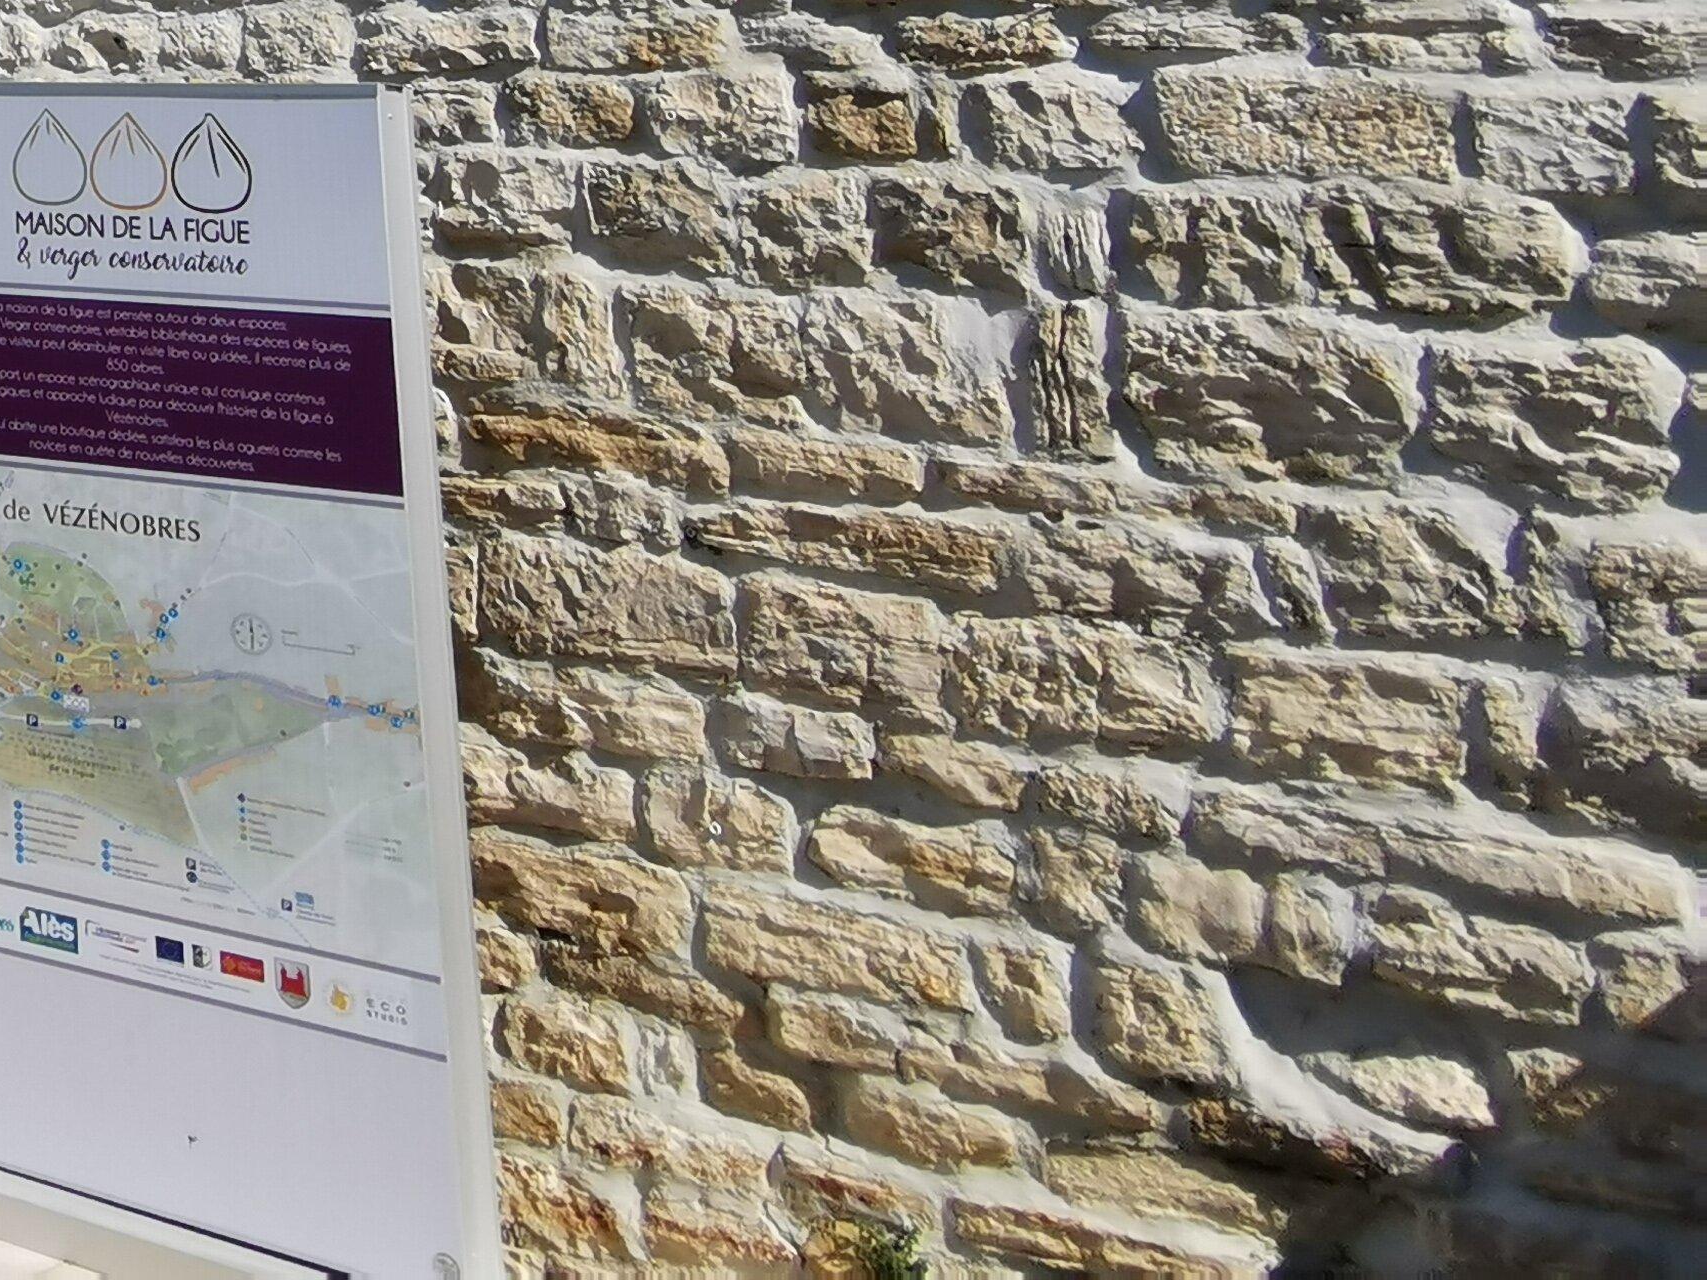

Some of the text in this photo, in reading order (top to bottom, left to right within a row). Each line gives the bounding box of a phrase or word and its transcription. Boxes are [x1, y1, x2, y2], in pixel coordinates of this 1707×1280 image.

[16, 211, 250, 244] MAISON DE LA FIGUE
[17, 236, 249, 280] & verger conservatoire
[6, 303, 37, 314] maison
[41, 304, 56, 316] de
[57, 305, 68, 317] la
[69, 305, 94, 319] figue
[96, 307, 111, 319] est
[114, 308, 152, 322] pensée
[155, 313, 188, 323] autour
[191, 313, 207, 325] de
[209, 314, 236, 327] deux
[0, 317, 31, 332] Verger
[104, 325, 149, 339] véritable
[151, 327, 218, 345] bibliothèque
[220, 333, 240, 346] des
[243, 336, 290, 351] espèces
[292, 337, 309, 351] de
[8, 335, 40, 349] visiteur
[42, 337, 66, 352] peut
[67, 340, 121, 354] déambuler
[123, 344, 137, 355] en
[139, 344, 165, 357] visite
[167, 345, 189, 359] libre
[192, 349, 207, 361] ou
[262, 356, 306, 369] recense
[308, 357, 331, 373] plus
[334, 358, 351, 371] de
[106, 357, 129, 372] 850
[23, 370, 35, 381] un
[37, 372, 76, 386] espace
[78, 375, 161, 392] scénographique
[163, 383, 199, 397] unique
[201, 385, 218, 399] qui
[221, 386, 272, 402] conjugue
[274, 391, 326, 406] contenus
[33, 389, 44, 399] et
[46, 390, 97, 404] approche
[98, 392, 137, 409] ludique
[139, 398, 163, 410] pour
[166, 398, 214, 414] découvrir
[260, 405, 277, 419] de
[279, 406, 291, 421] la
[293, 408, 322, 425] figue
[8, 418, 37, 432] abrite
[38, 423, 58, 435] une
[60, 423, 106, 439] boutique
[196, 436, 211, 449] les
[213, 438, 234, 452] plus
[282, 446, 323, 460] comme
[325, 447, 342, 462] les
[29, 440, 67, 453] novices
[69, 443, 83, 454] en
[85, 444, 115, 458] quête
[118, 445, 133, 460] de
[135, 449, 183, 465] nouvelles
[3, 498, 31, 522] de
[43, 499, 201, 542] VÉZÉNOBRES
[23, 910, 75, 942] Alès
[366, 998, 406, 1015] ECO
